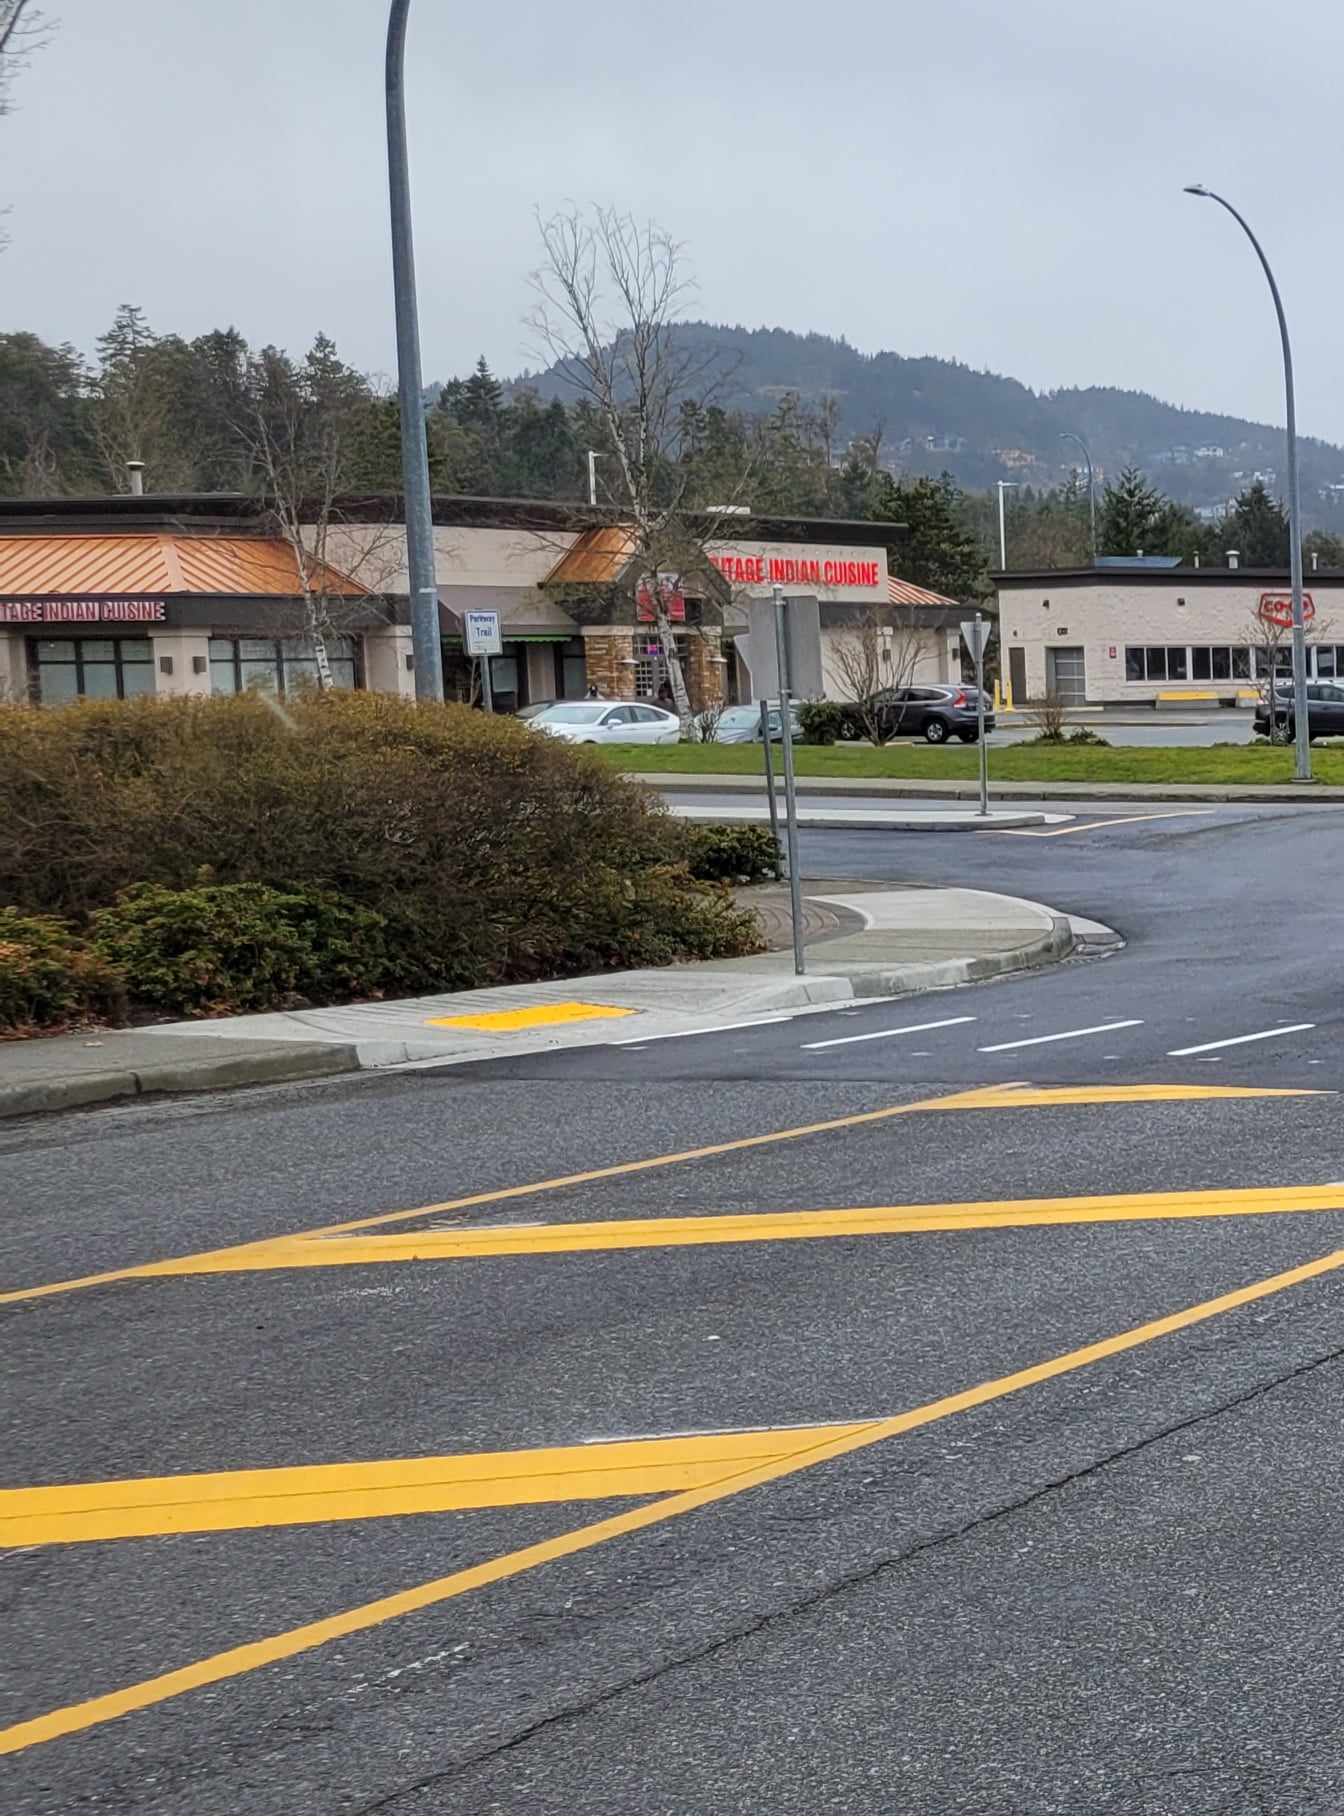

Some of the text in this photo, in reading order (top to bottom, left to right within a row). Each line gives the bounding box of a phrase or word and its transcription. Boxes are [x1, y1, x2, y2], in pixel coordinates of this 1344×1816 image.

[768, 558, 819, 585] INDIAN
[823, 560, 879, 587] CUISINE
[43, 602, 99, 621] INDIAN
[100, 601, 165, 621] CUISINE
[476, 627, 492, 638] Trail
